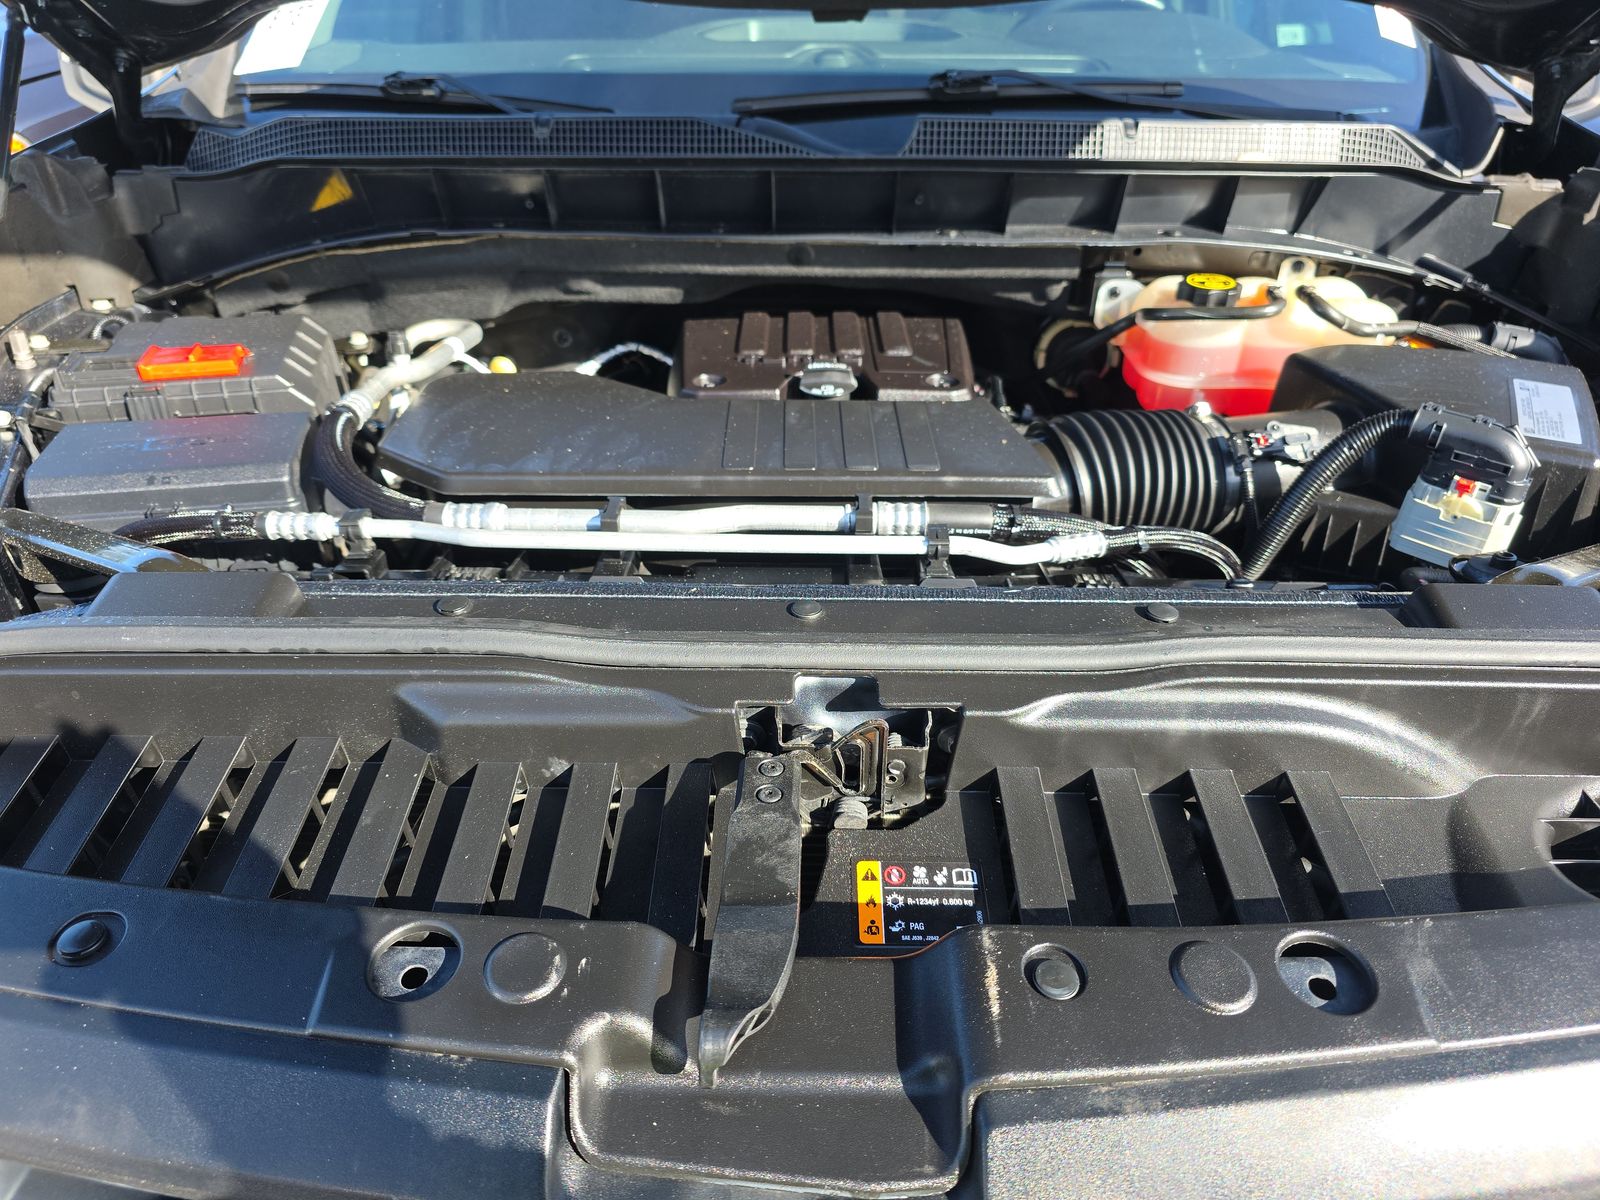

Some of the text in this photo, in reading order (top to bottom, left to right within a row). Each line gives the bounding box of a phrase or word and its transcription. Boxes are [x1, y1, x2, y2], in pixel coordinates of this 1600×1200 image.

[907, 898, 973, 907] R-1234yf 0.600 kg
[909, 922, 925, 931] PAG
